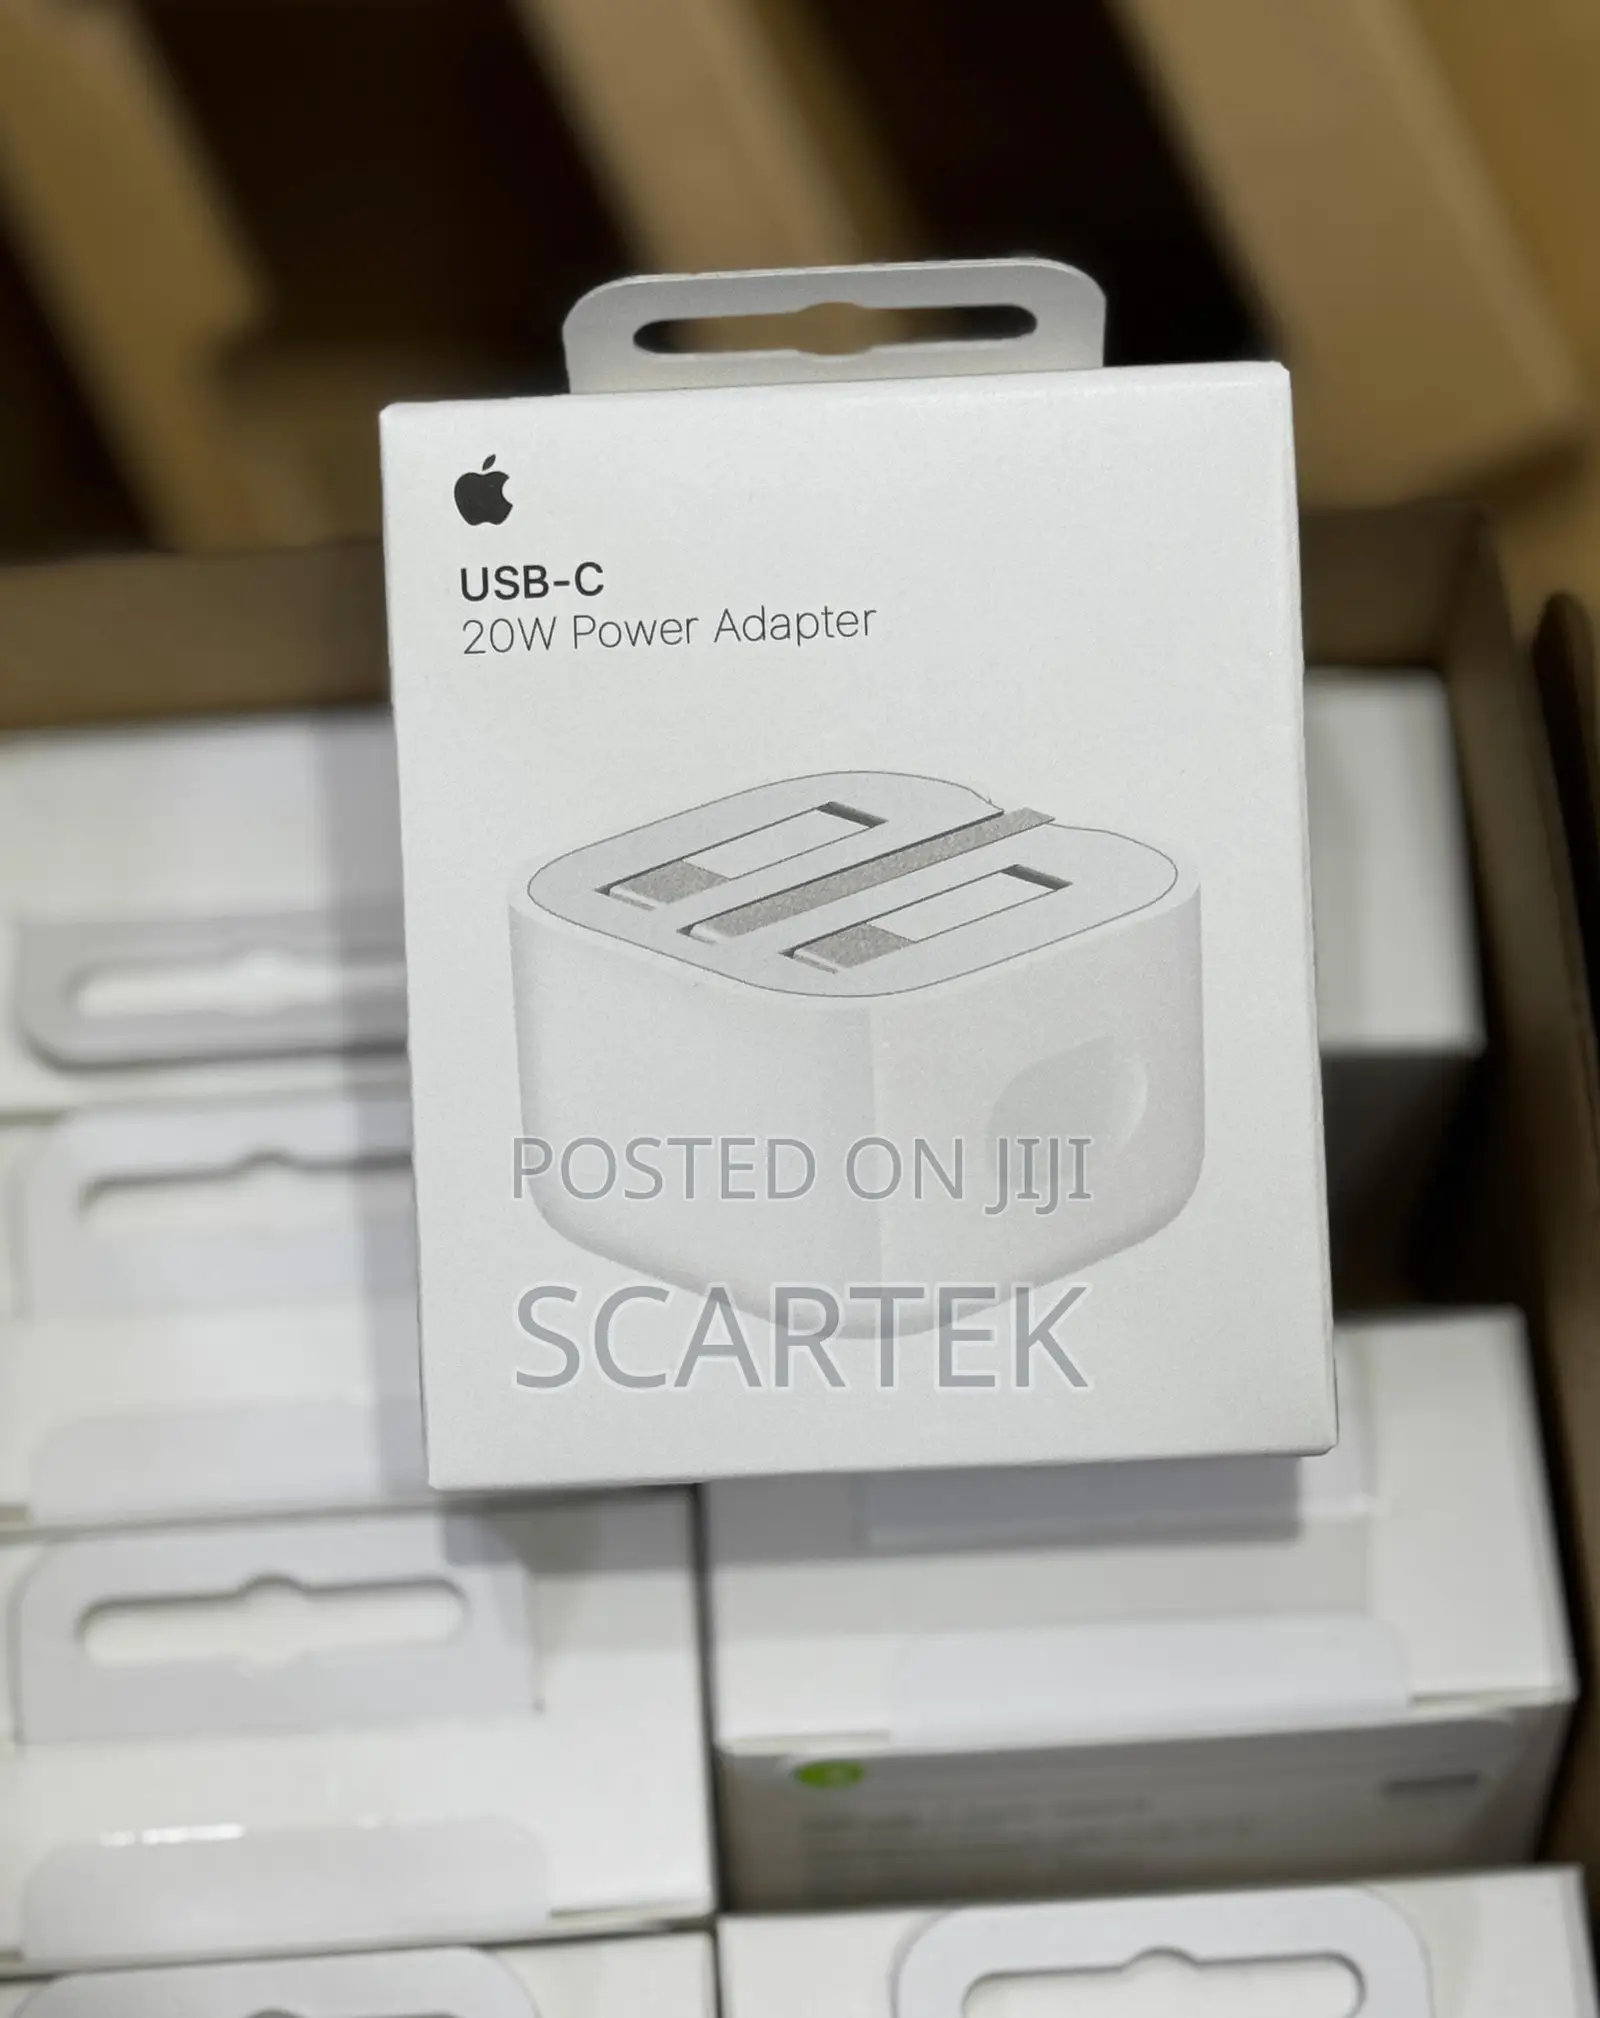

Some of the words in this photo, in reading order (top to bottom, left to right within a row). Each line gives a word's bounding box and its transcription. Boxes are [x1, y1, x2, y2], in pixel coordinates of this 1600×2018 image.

[460, 561, 605, 602] USB-C
[462, 616, 557, 655] 20W
[573, 613, 700, 650] Power
[713, 605, 877, 647] Adapter
